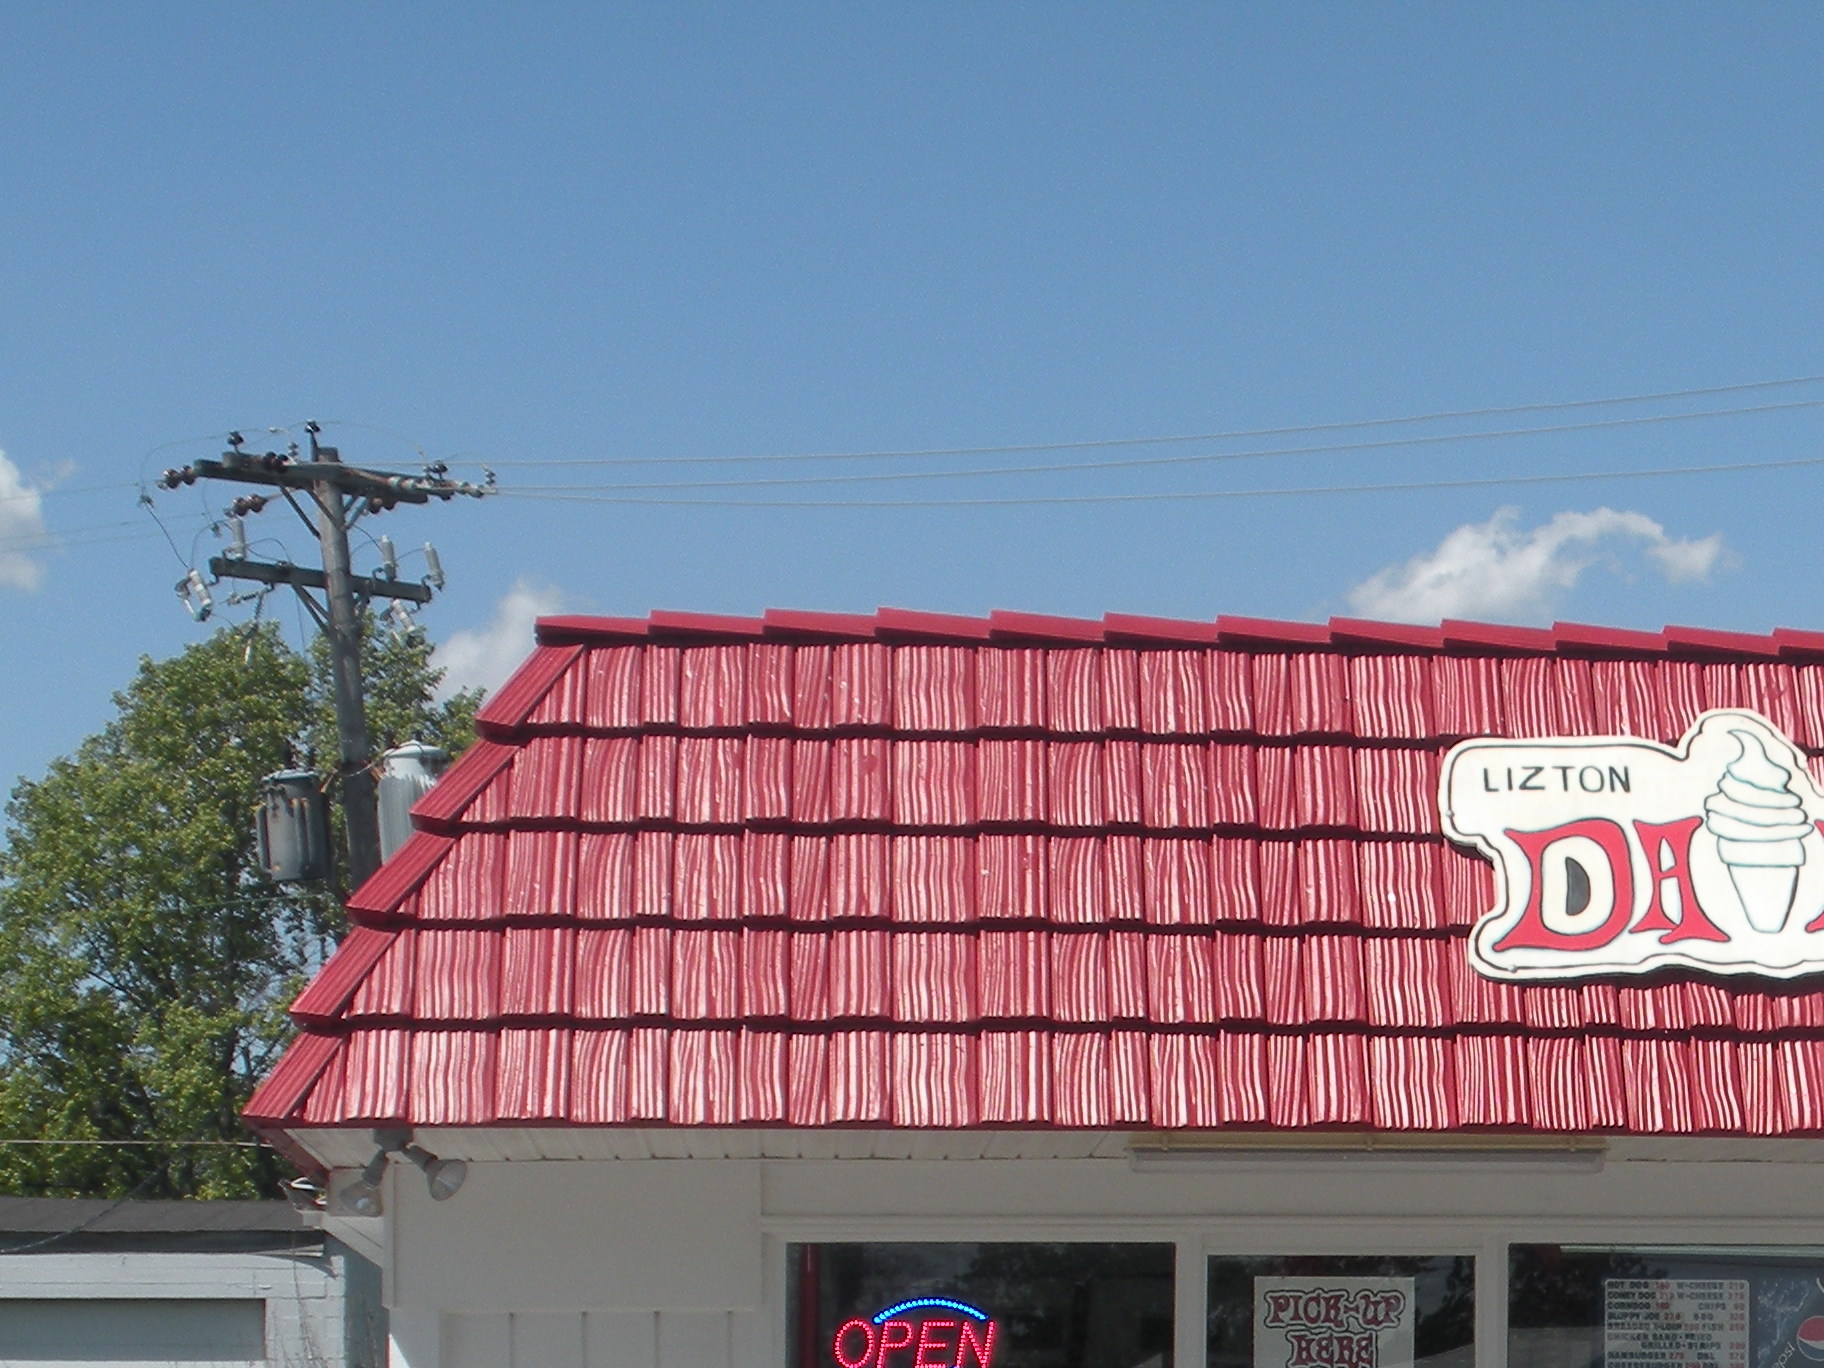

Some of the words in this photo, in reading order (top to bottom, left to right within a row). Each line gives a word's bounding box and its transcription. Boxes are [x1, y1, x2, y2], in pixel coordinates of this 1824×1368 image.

[1481, 763, 1632, 795] LIZTON
[1630, 1281, 1649, 1290] DOG
[1638, 1292, 1656, 1300] DOG
[1266, 1291, 1403, 1329] PICK-UP
[1698, 1302, 1726, 1310] CHIPS
[1701, 1323, 1724, 1331] FISH
[1607, 1352, 1666, 1360] HAMBURGER
